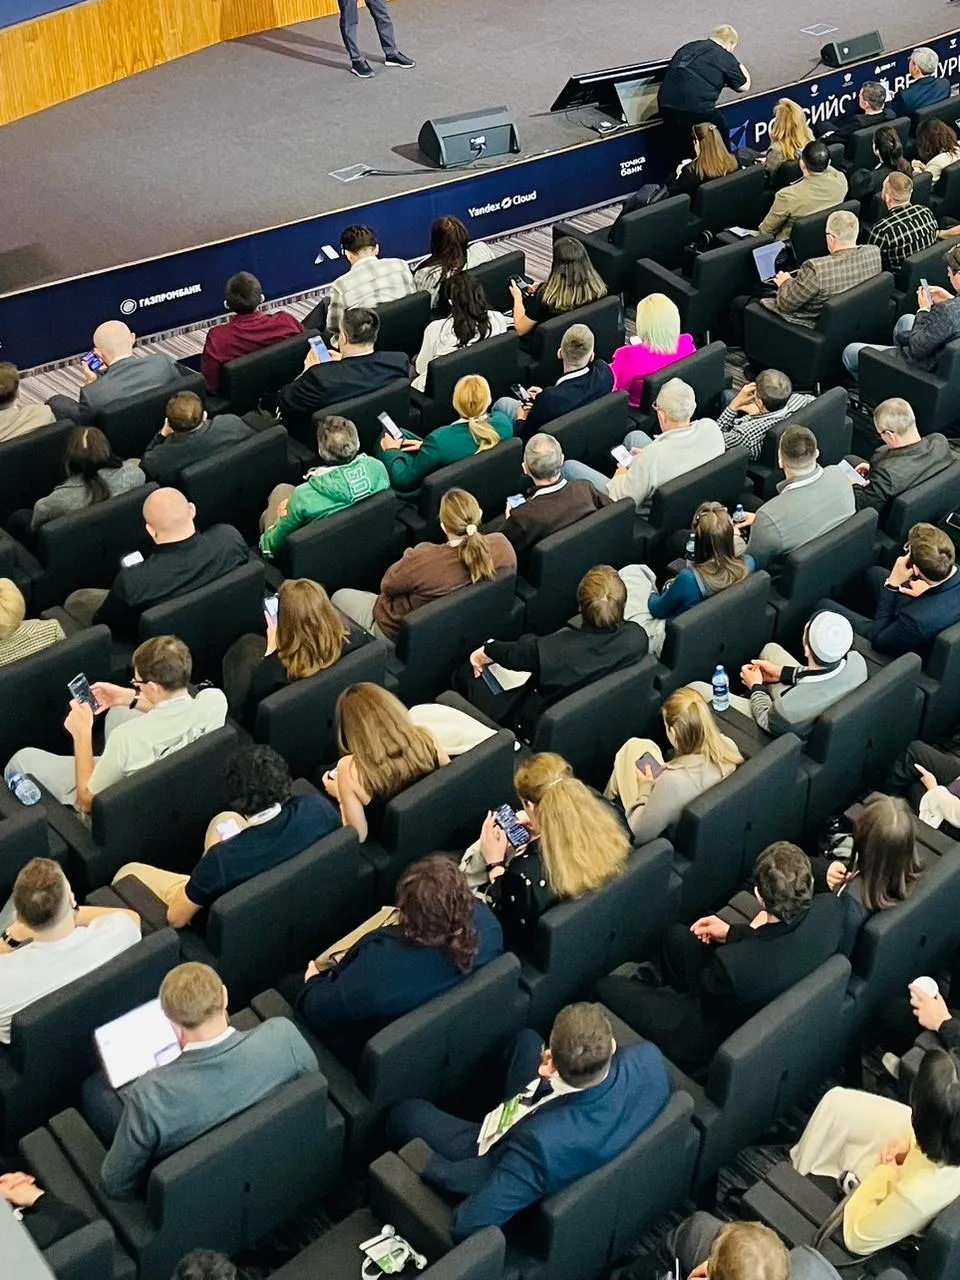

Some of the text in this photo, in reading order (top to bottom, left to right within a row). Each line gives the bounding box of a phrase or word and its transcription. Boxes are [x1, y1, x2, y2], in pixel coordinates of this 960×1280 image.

[468, 190, 537, 218] Yandex Cloud
[138, 283, 202, 308] ГАЗПРОМБАНК
